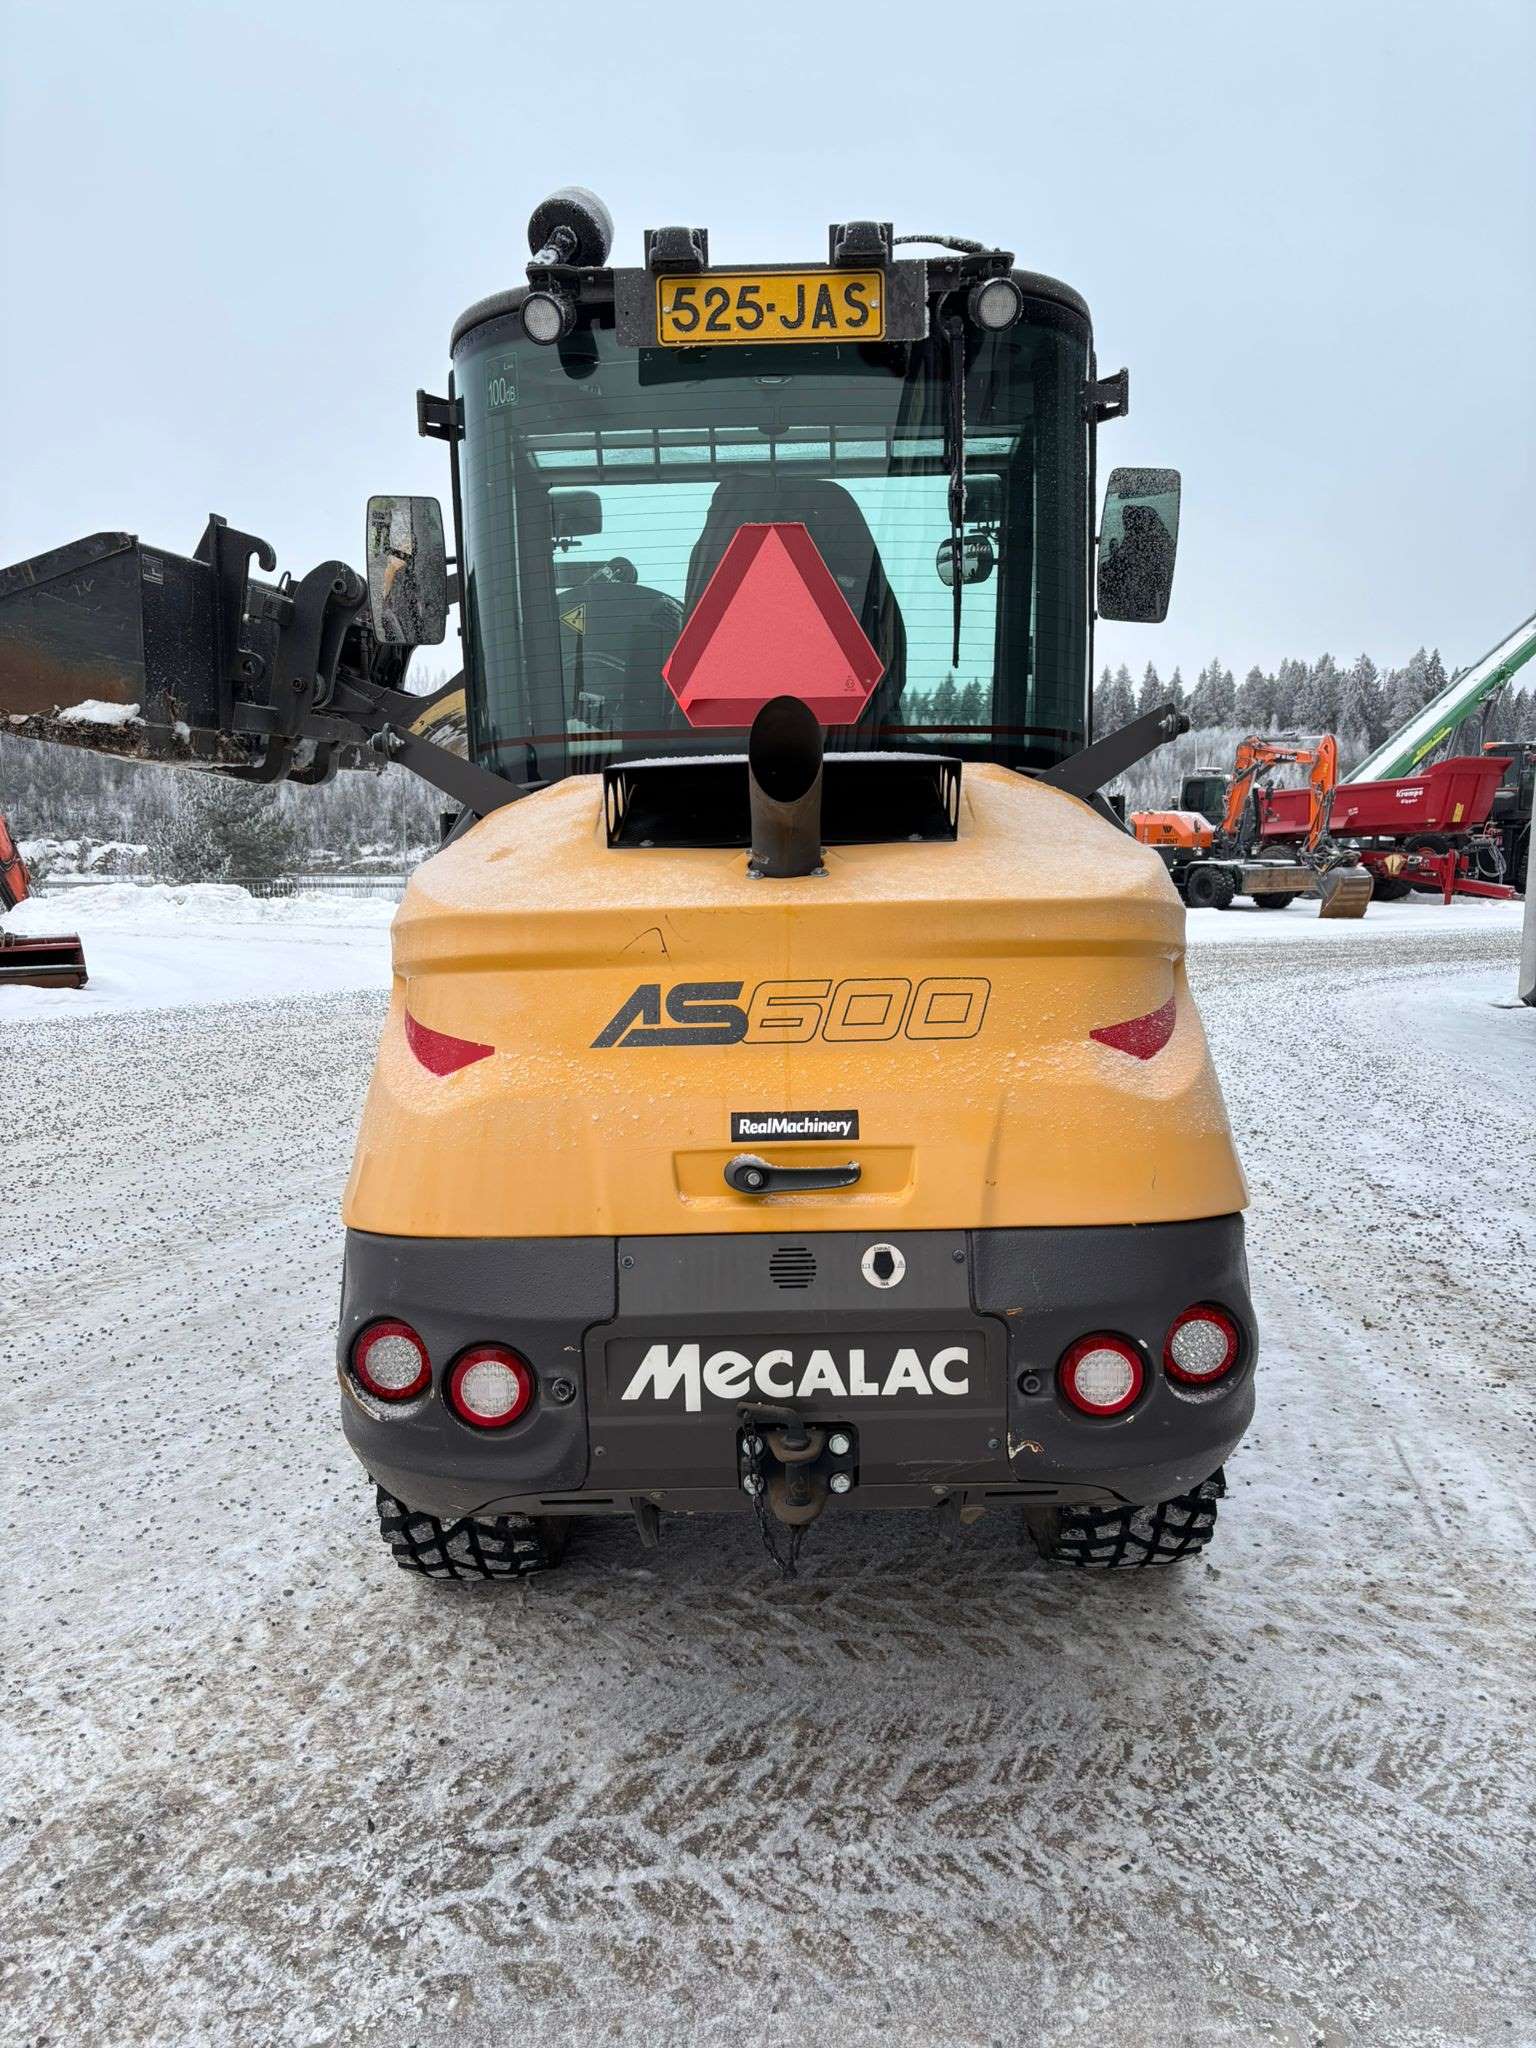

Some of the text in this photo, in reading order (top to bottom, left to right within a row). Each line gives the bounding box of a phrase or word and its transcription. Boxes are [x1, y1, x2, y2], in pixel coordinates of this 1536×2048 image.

[671, 282, 869, 332] 525-JAS
[589, 977, 991, 1049] AS600
[739, 1117, 852, 1136] RealMachinery
